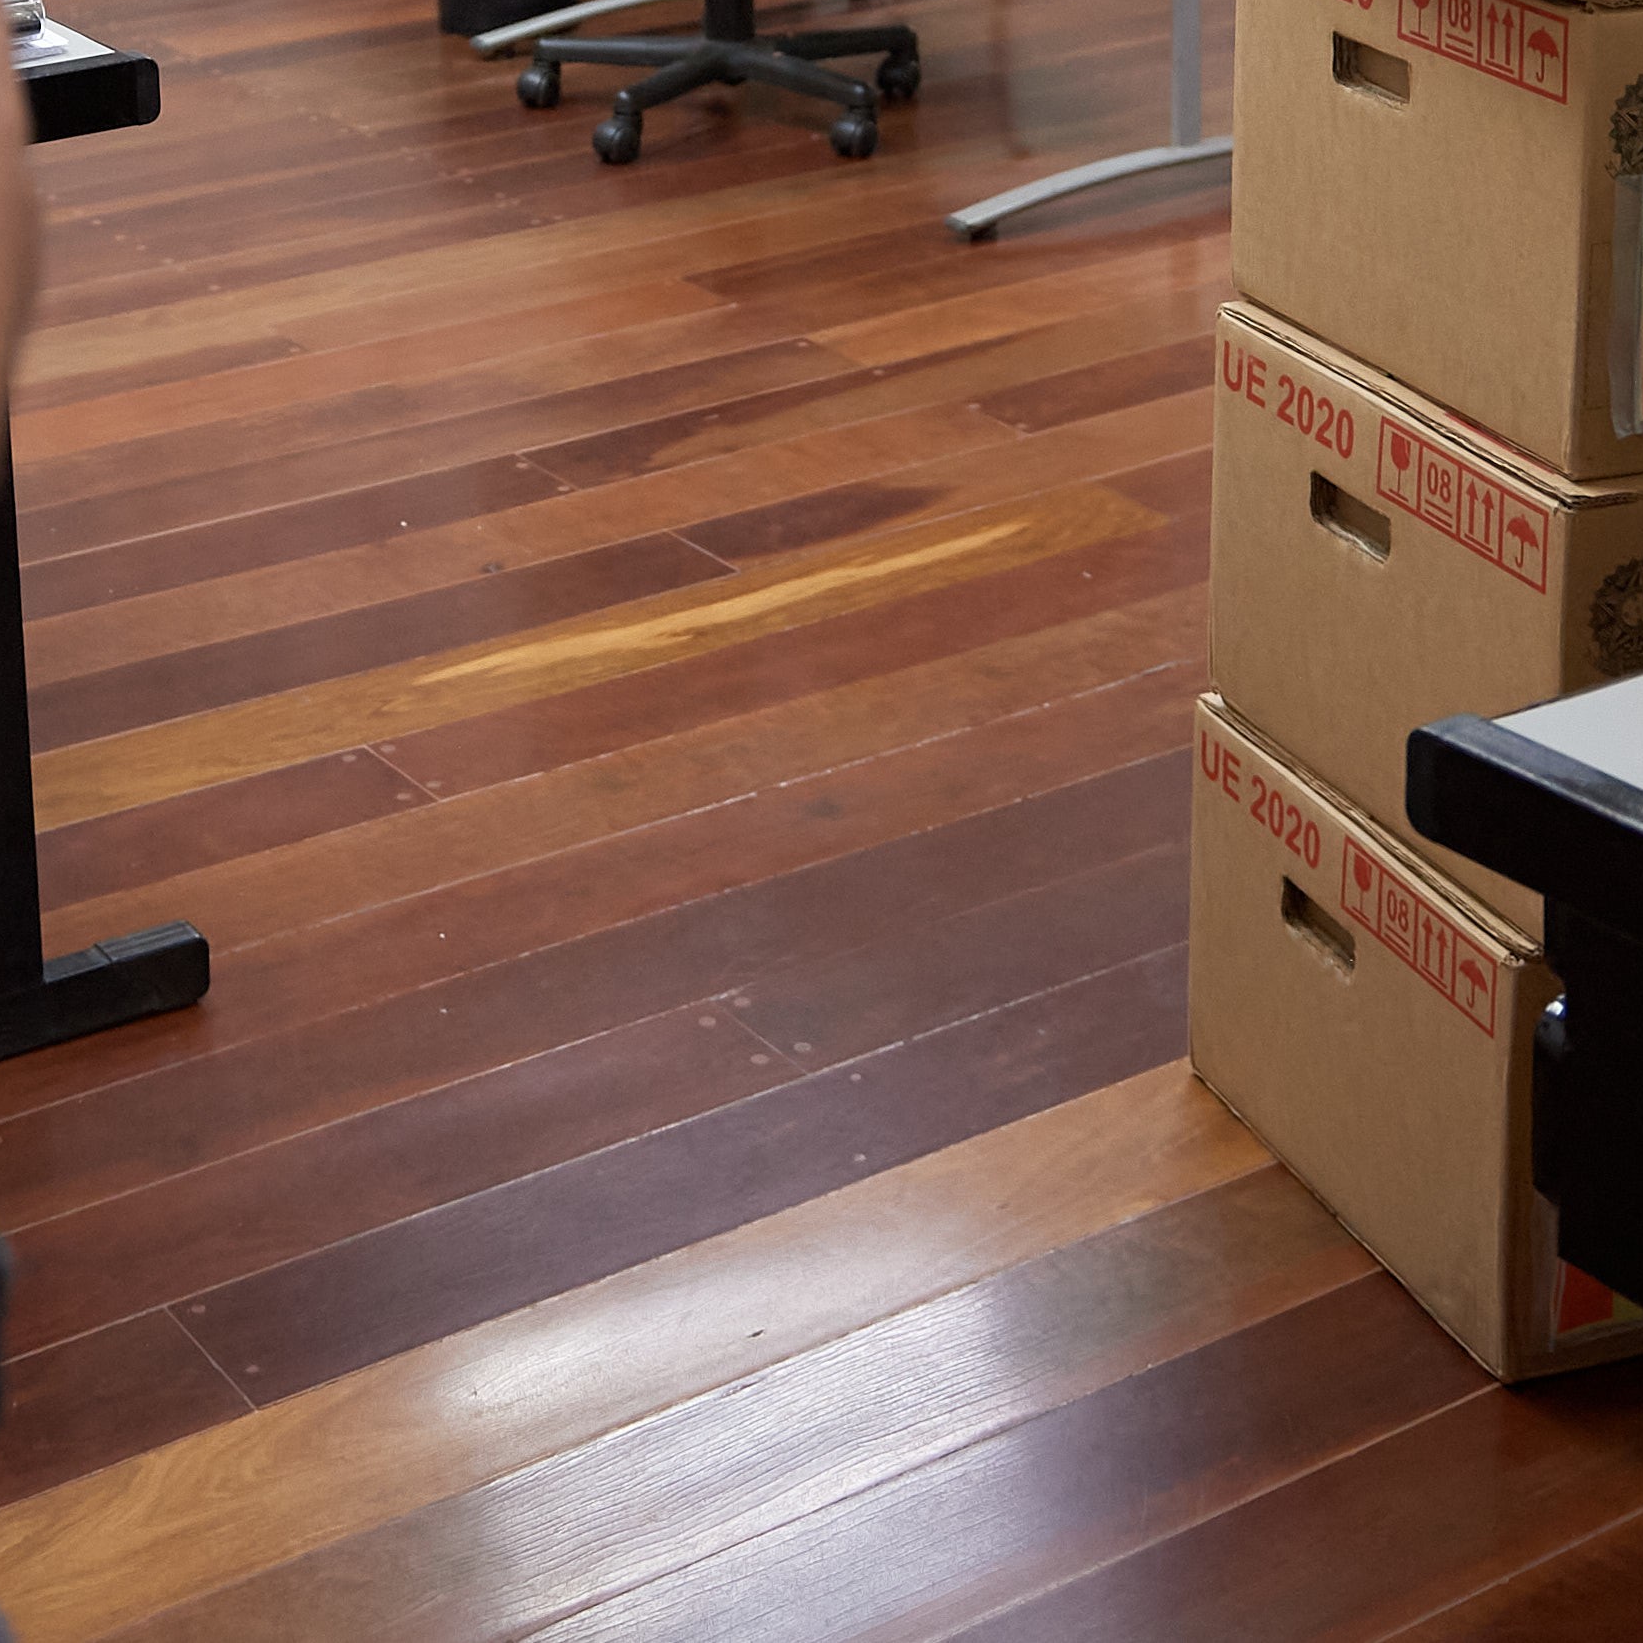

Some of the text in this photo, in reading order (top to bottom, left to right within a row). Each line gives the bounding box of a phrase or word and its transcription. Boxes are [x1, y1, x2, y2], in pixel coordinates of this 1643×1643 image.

[1223, 340, 1354, 459] UE 2020
[1426, 462, 1451, 504] 08
[1201, 730, 1321, 869] UE 2020
[1387, 890, 1408, 932] 08
